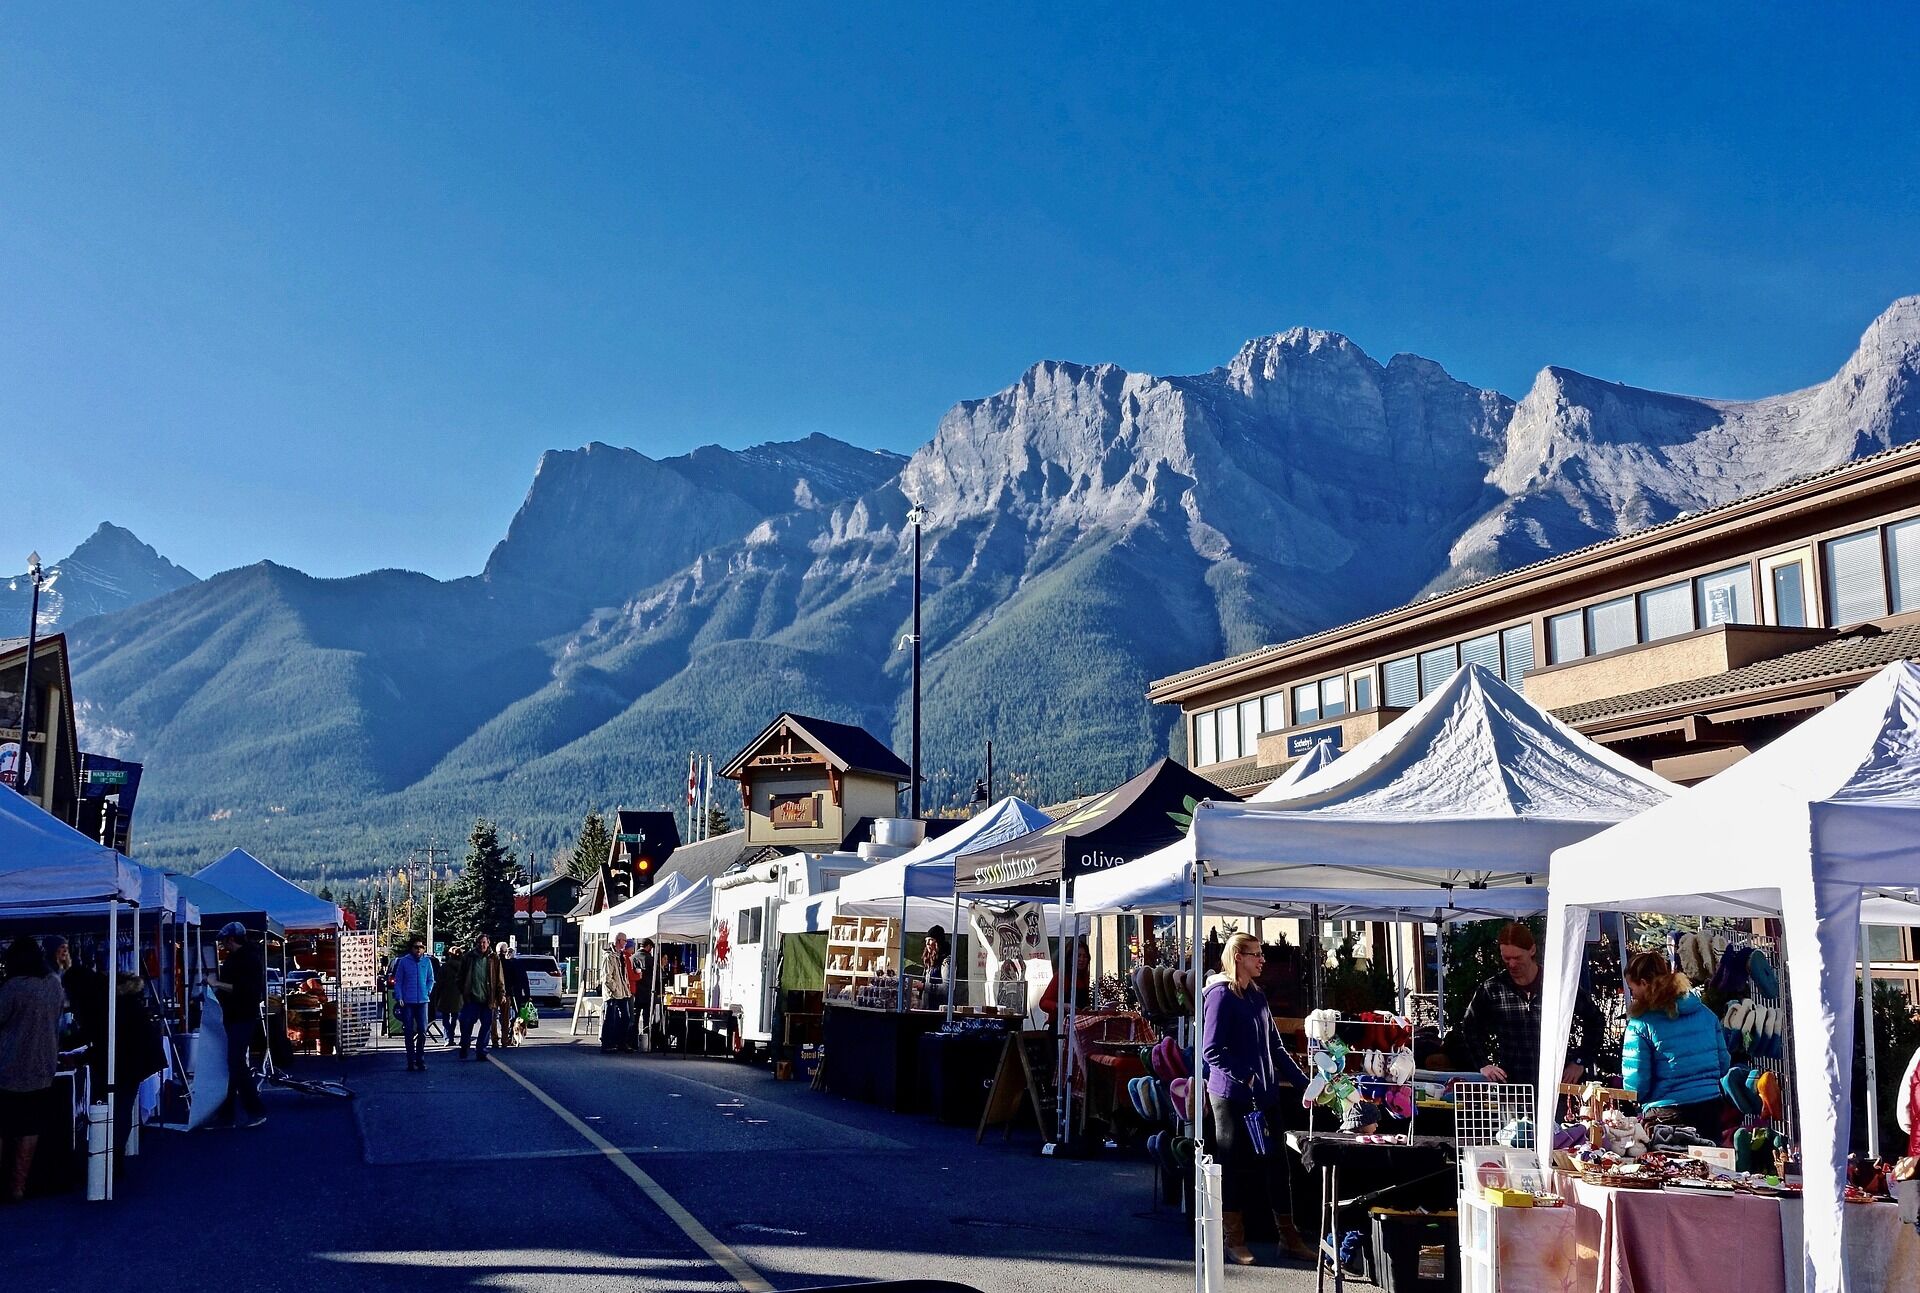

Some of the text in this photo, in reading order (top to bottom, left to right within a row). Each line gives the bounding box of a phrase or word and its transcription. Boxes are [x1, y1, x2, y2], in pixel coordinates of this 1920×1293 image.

[1294, 737, 1312, 748] Sotheby's
[780, 801, 808, 811] Village
[1081, 851, 1125, 867] olive
[975, 851, 1038, 885] evoolution
[801, 1051, 816, 1060] Special
